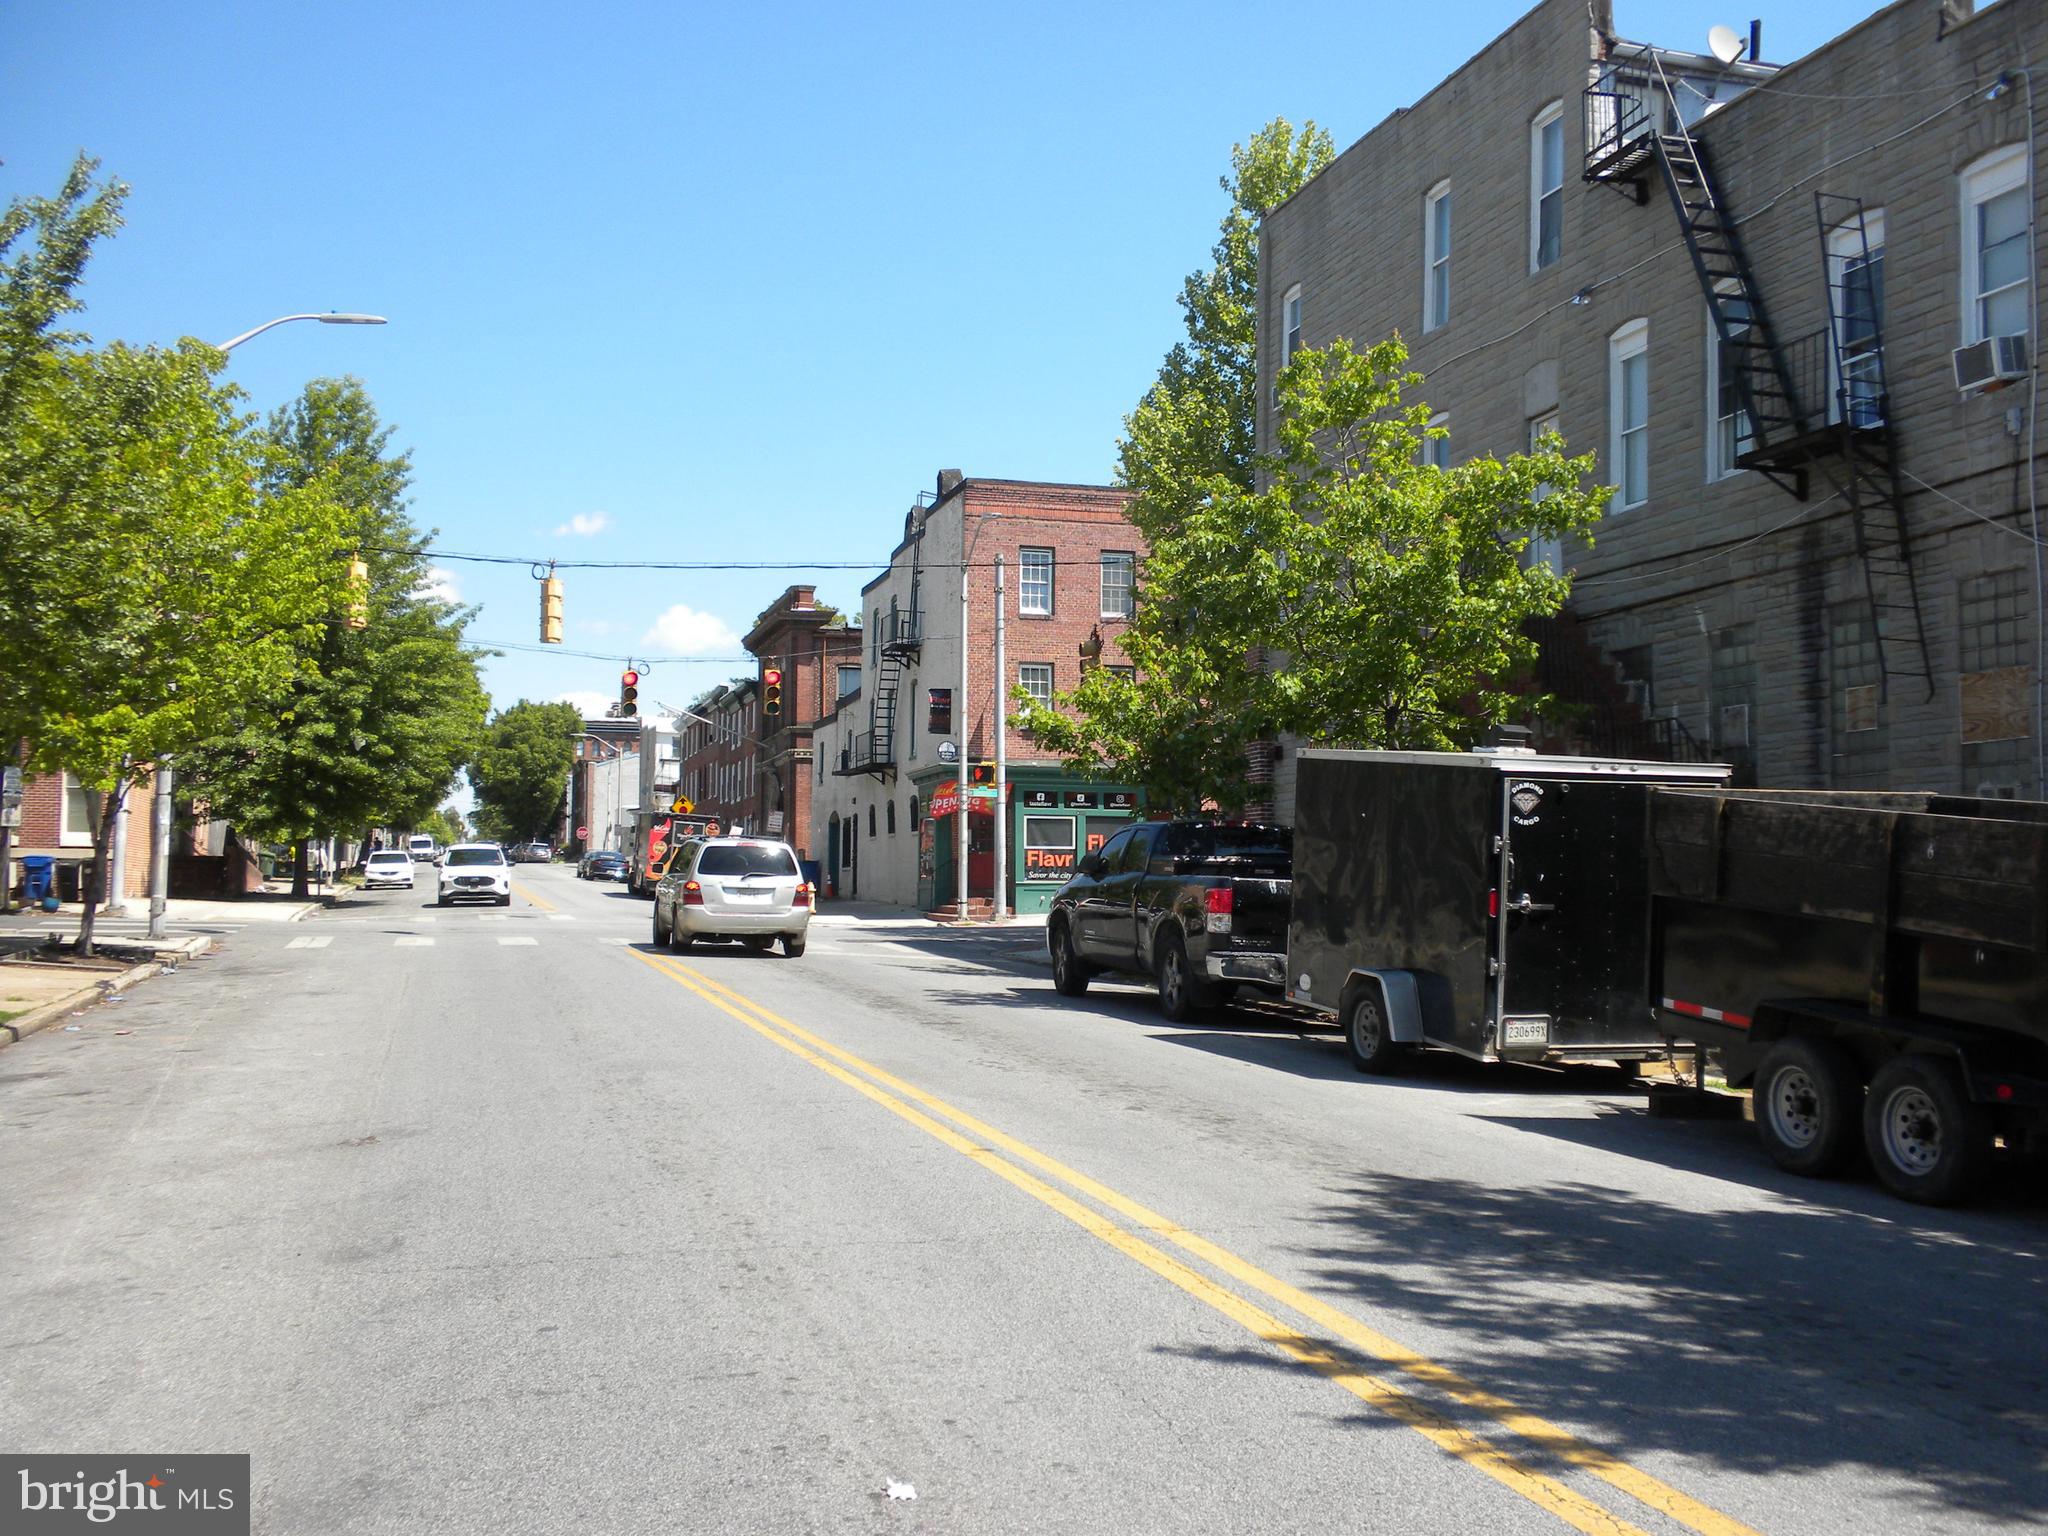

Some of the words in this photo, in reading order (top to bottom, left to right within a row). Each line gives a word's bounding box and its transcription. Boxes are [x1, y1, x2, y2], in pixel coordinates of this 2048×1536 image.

[1511, 782, 1545, 795] DIAMOND
[1513, 816, 1541, 826] CARGO
[1027, 851, 1073, 867] Flavr
[1028, 871, 1047, 879] Savor
[1060, 872, 1073, 880] city
[1508, 1026, 1546, 1038] 230699X
